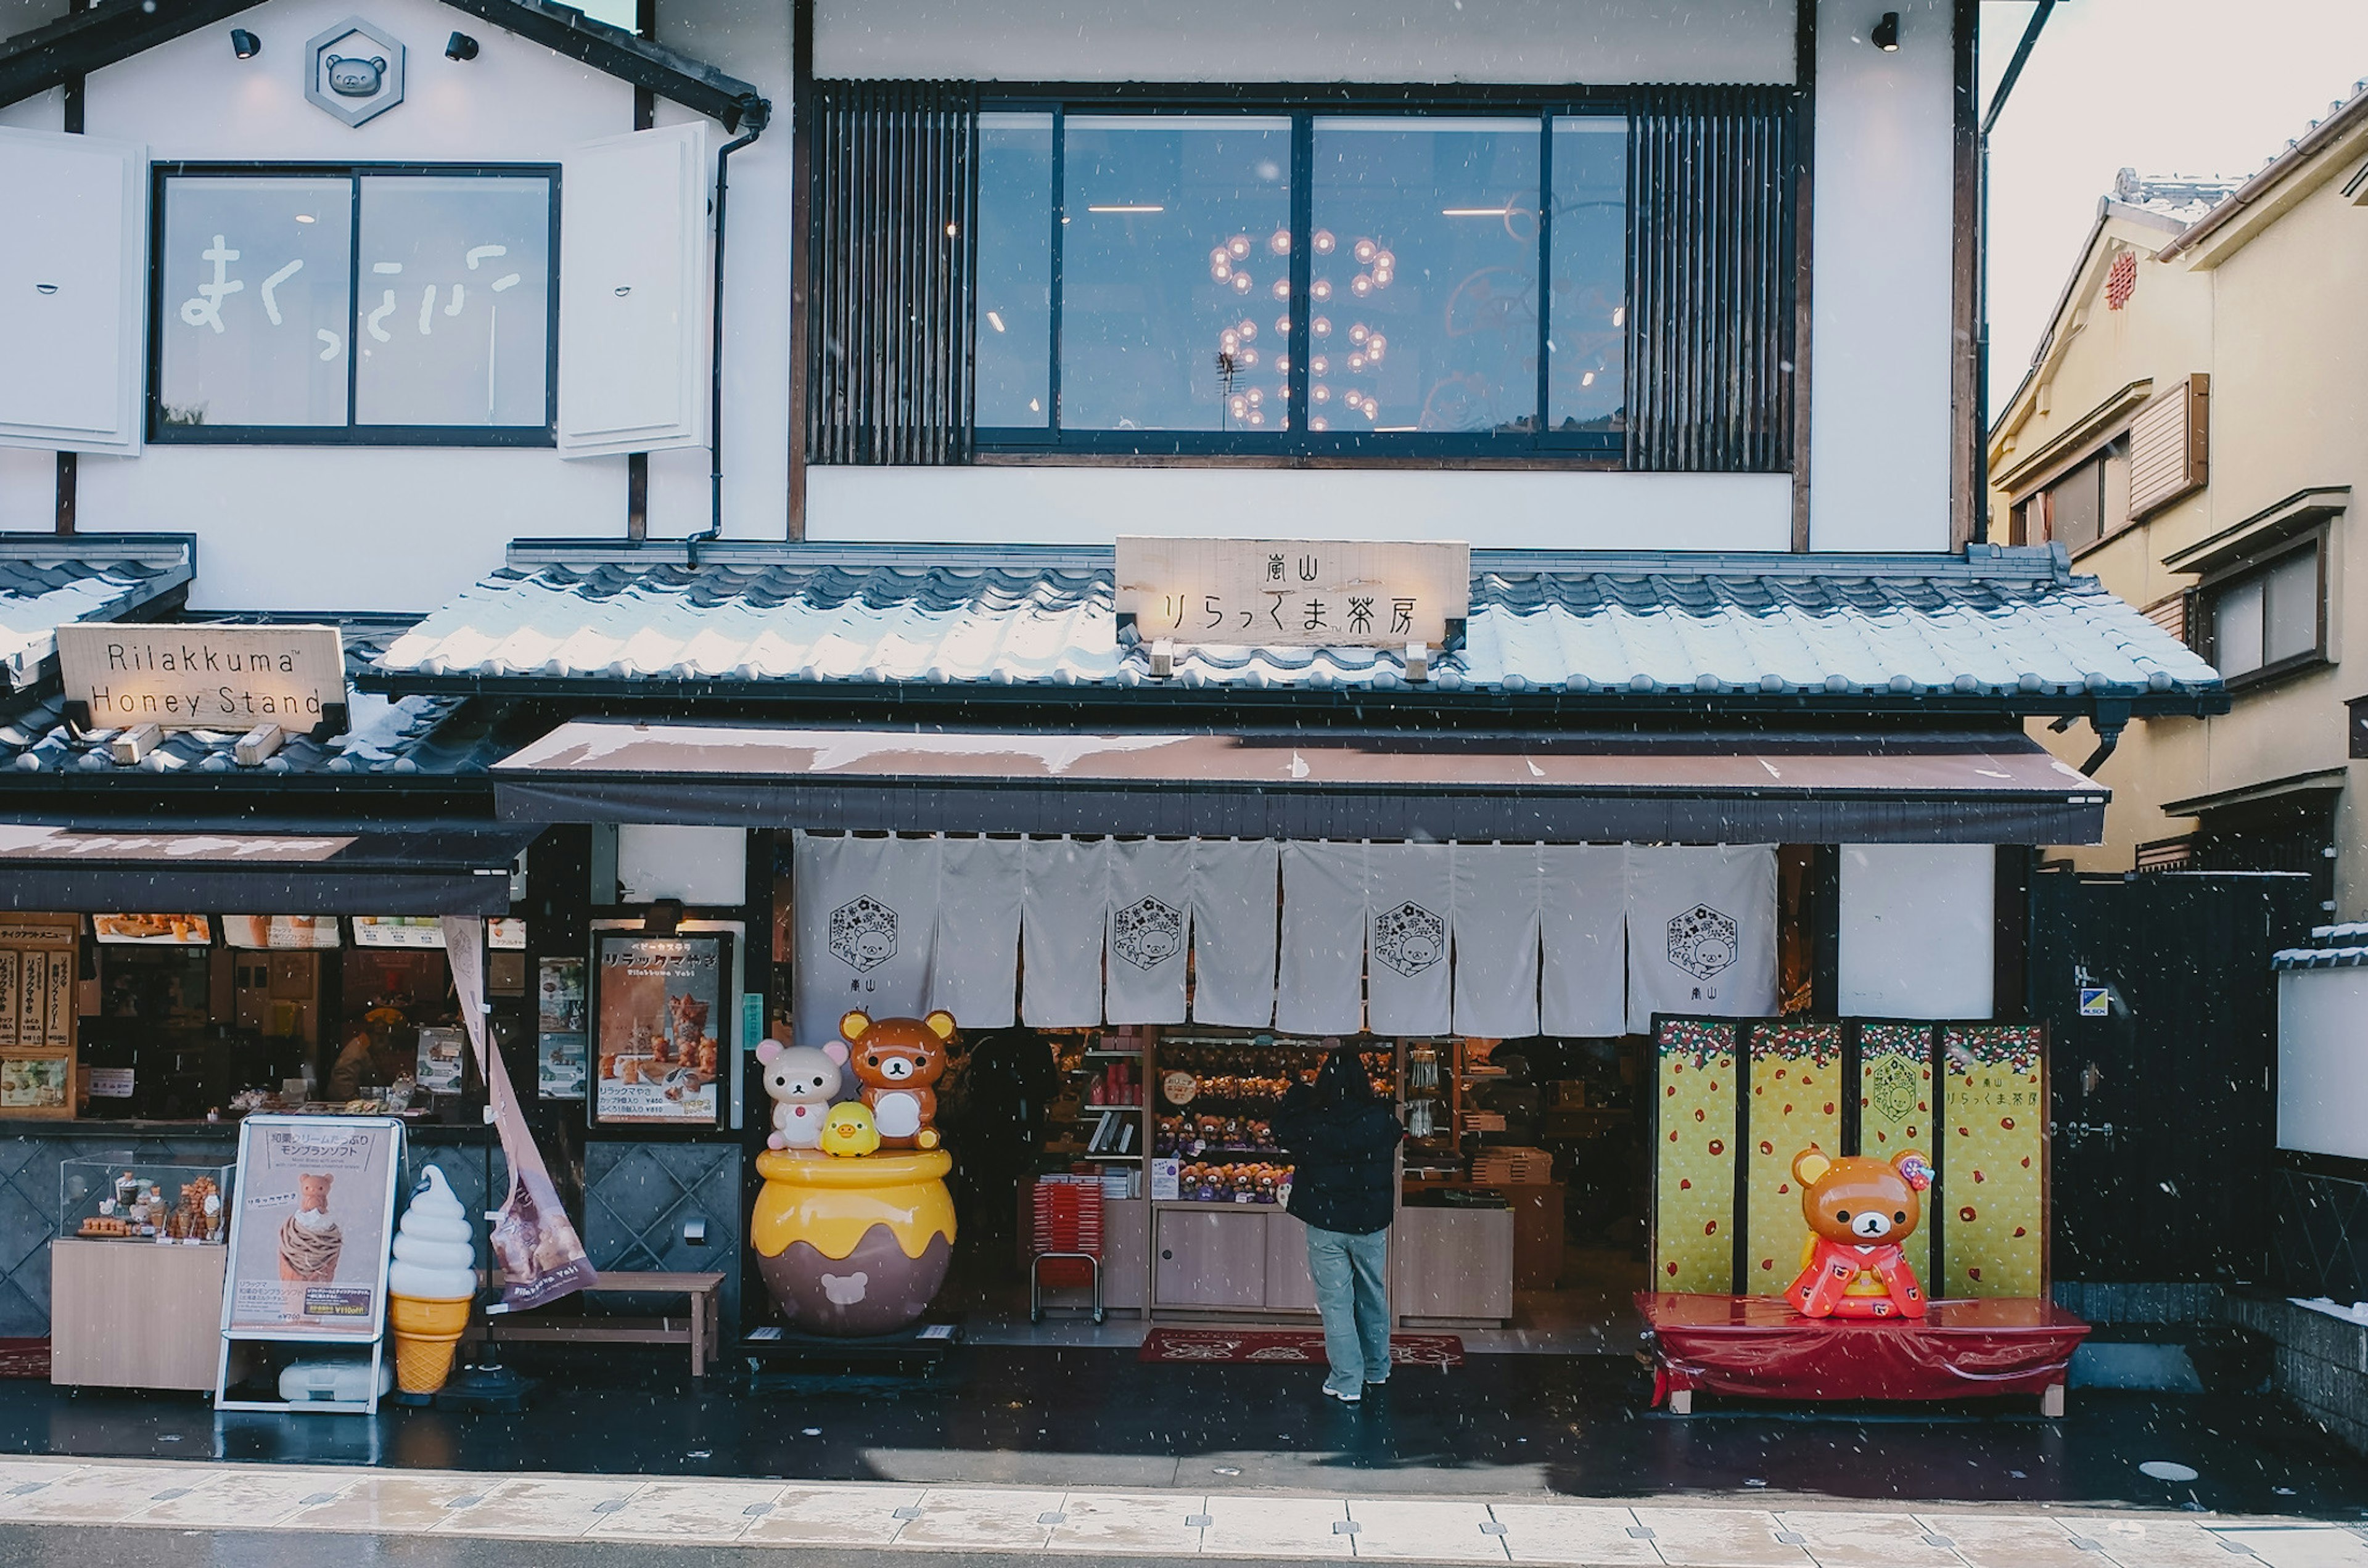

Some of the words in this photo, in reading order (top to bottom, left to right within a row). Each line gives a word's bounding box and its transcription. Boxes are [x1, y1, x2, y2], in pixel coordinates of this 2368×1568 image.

[1265, 553, 1318, 583] 嵐山
[92, 685, 201, 717] Honey
[220, 686, 321, 715] Stand
[631, 943, 691, 951] ベビーカステラ
[604, 952, 718, 969] リラックマやき
[599, 1086, 651, 1096] リラックマやき
[271, 1132, 369, 1146] 和栗クリームたっぷり
[281, 1145, 357, 1156] モンブランソフト
